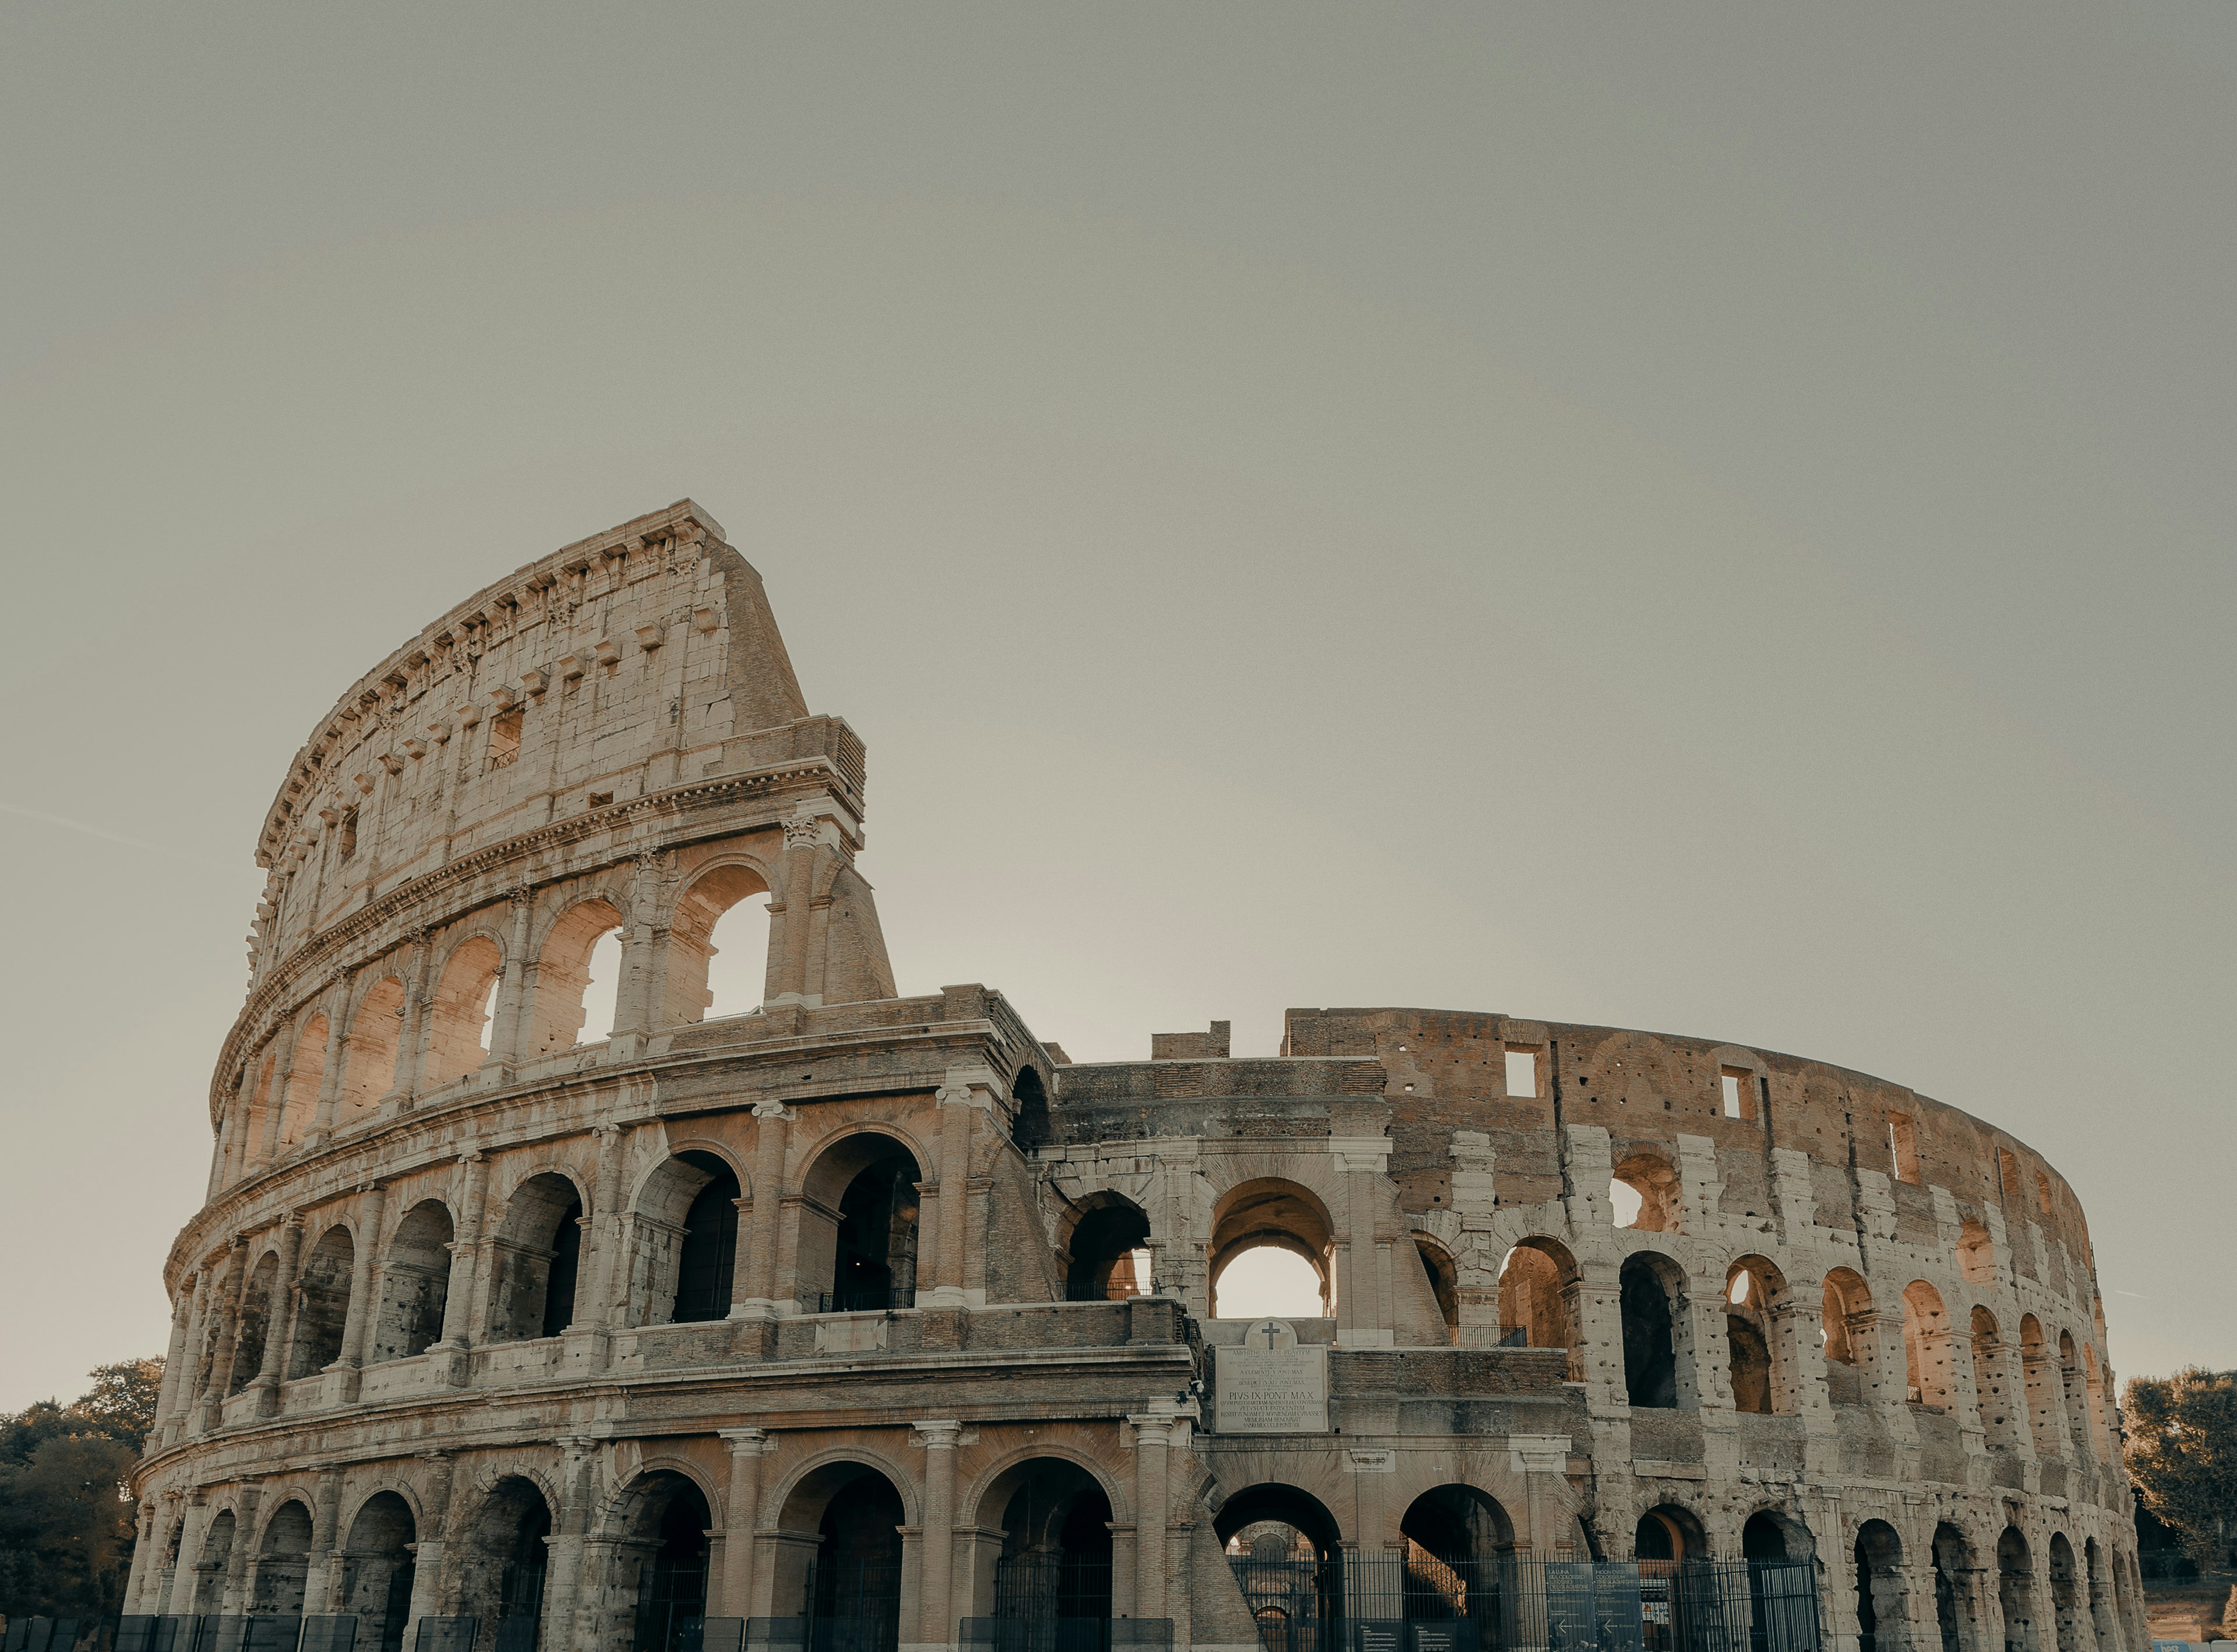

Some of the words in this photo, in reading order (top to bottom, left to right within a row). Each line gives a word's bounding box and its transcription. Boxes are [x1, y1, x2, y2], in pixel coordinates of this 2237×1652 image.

[1229, 1392, 1250, 1400] PIVS
[1251, 1392, 1261, 1400] IX
[1264, 1392, 1288, 1400] PONT
[1290, 1391, 1314, 1400] MAX
